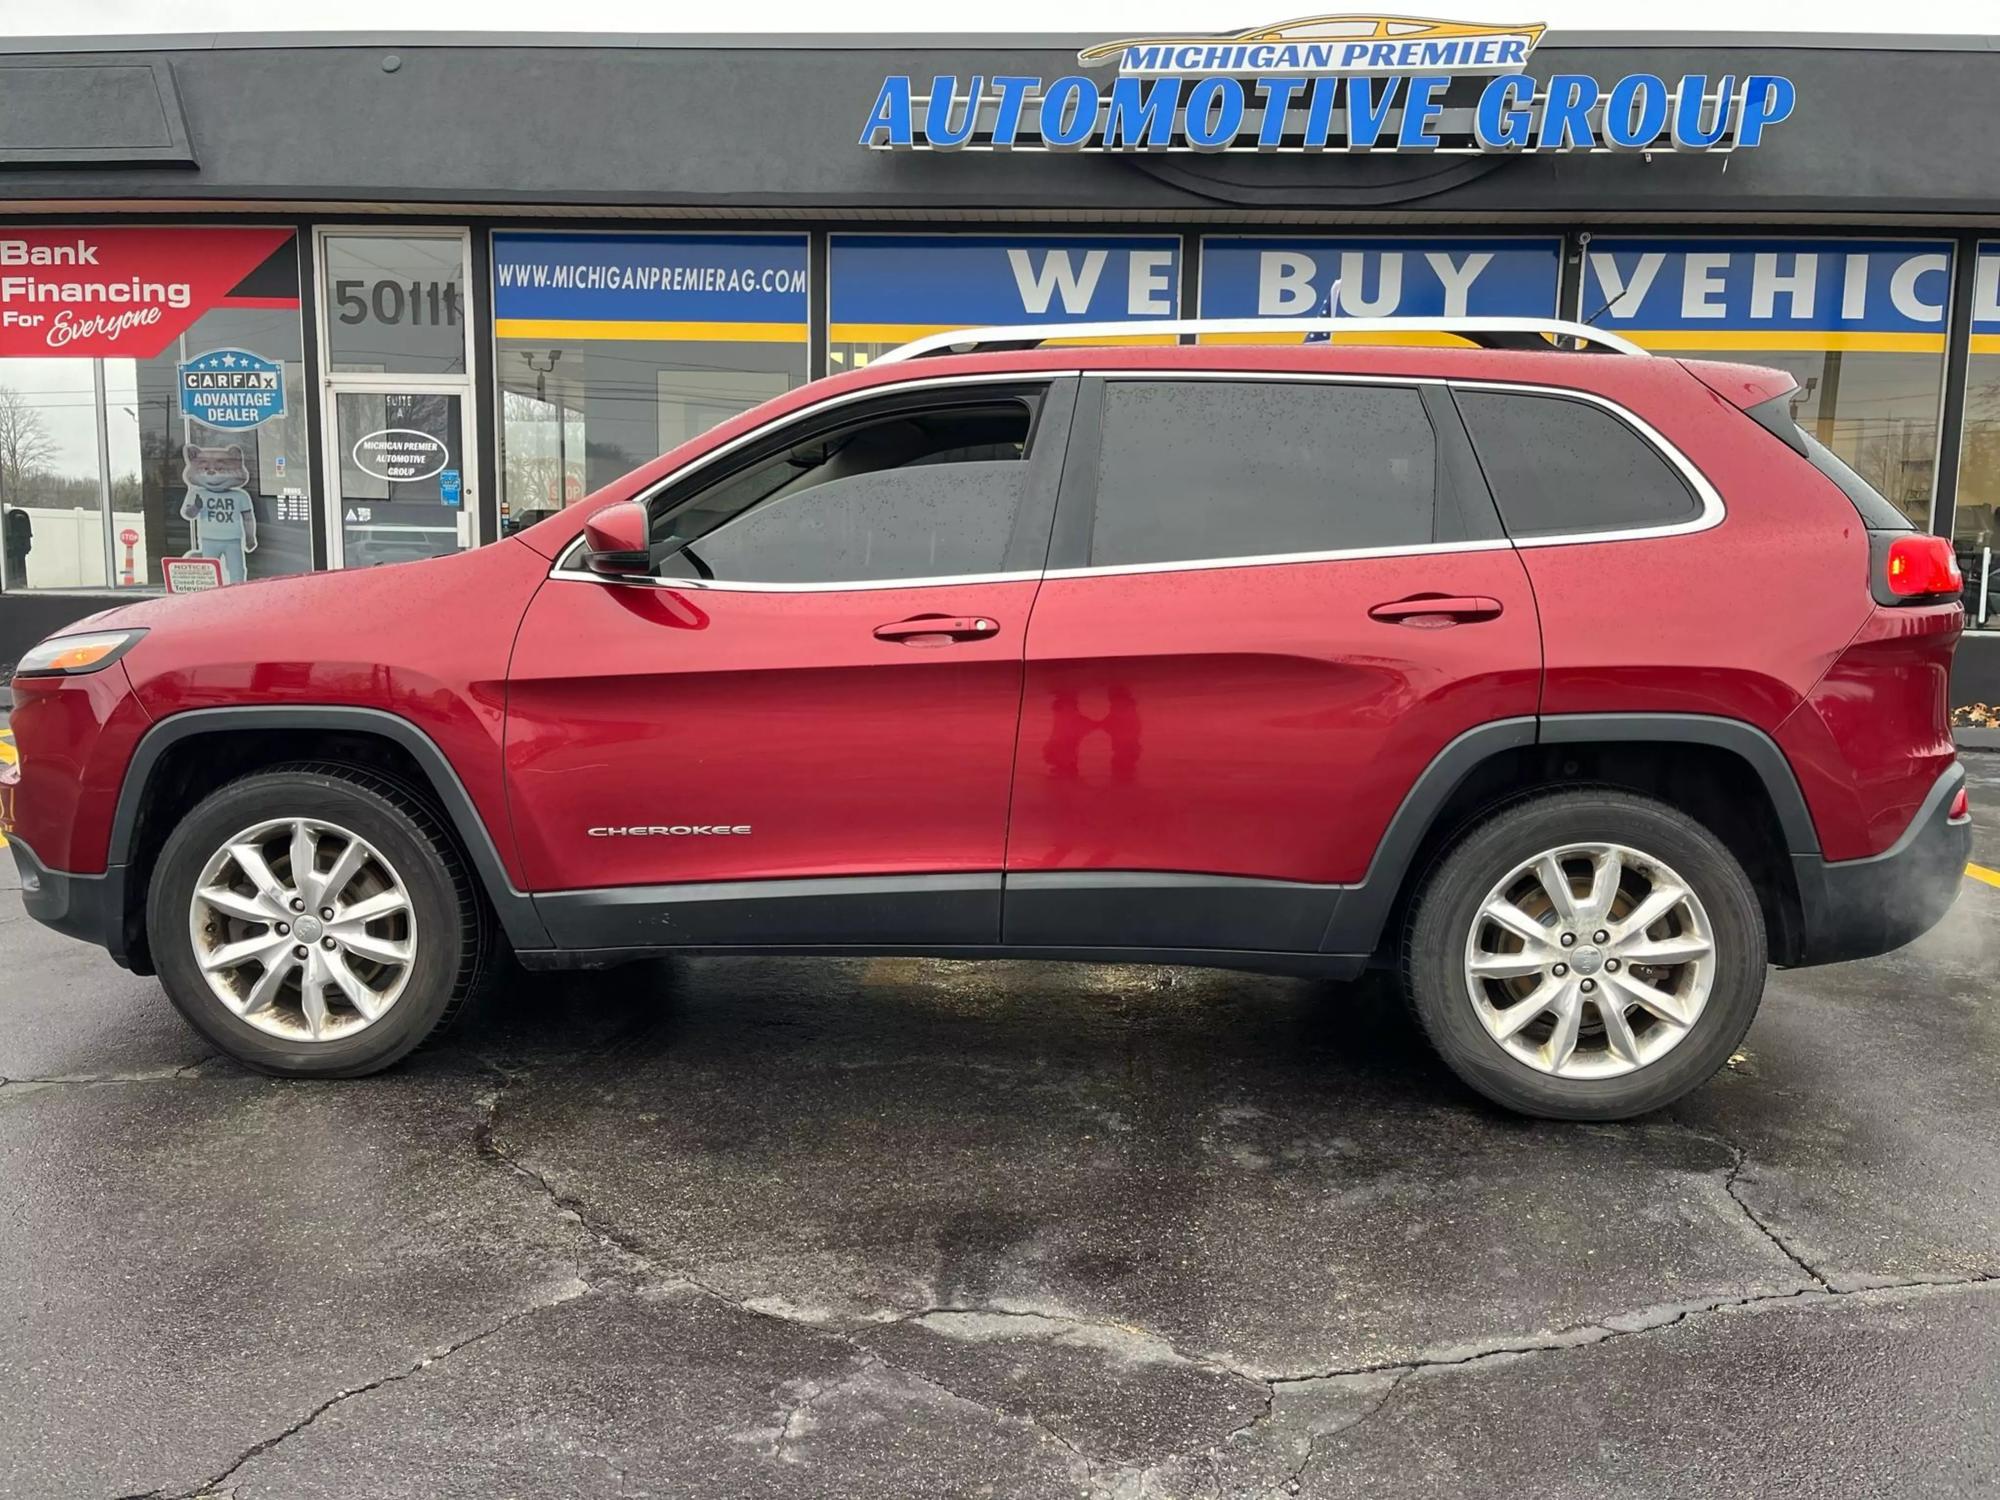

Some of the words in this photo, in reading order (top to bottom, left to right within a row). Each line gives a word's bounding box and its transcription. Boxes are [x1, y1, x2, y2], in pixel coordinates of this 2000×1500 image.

[1122, 44, 1332, 70] MICHIGAN
[1341, 40, 1526, 67] PREMIER
[858, 75, 1451, 147] AUTOMOTIVE
[1477, 73, 1796, 148] GROUP
[0, 240, 99, 265] Bank
[498, 264, 806, 293] WWW.MICHIGANPREMIERAG.COM
[1007, 249, 1172, 315] WE
[1258, 251, 1494, 318] BUY
[1, 276, 190, 308] Financing
[3, 311, 44, 326] For
[46, 307, 161, 347] Everyone
[186, 372, 277, 389] CARFAX
[193, 392, 273, 407] ADVANTAGE
[386, 396, 412, 407] SUITE
[208, 408, 259, 421] DEALER
[397, 408, 404, 418] A
[363, 441, 402, 451] MICHIGAN
[403, 442, 438, 451] PREMIER
[375, 455, 426, 464] AUTOMOTIVE
[387, 468, 415, 476] GROUP
[206, 498, 235, 510] CAR
[207, 511, 235, 523] FOX
[588, 825, 752, 837] CHEROKEE
